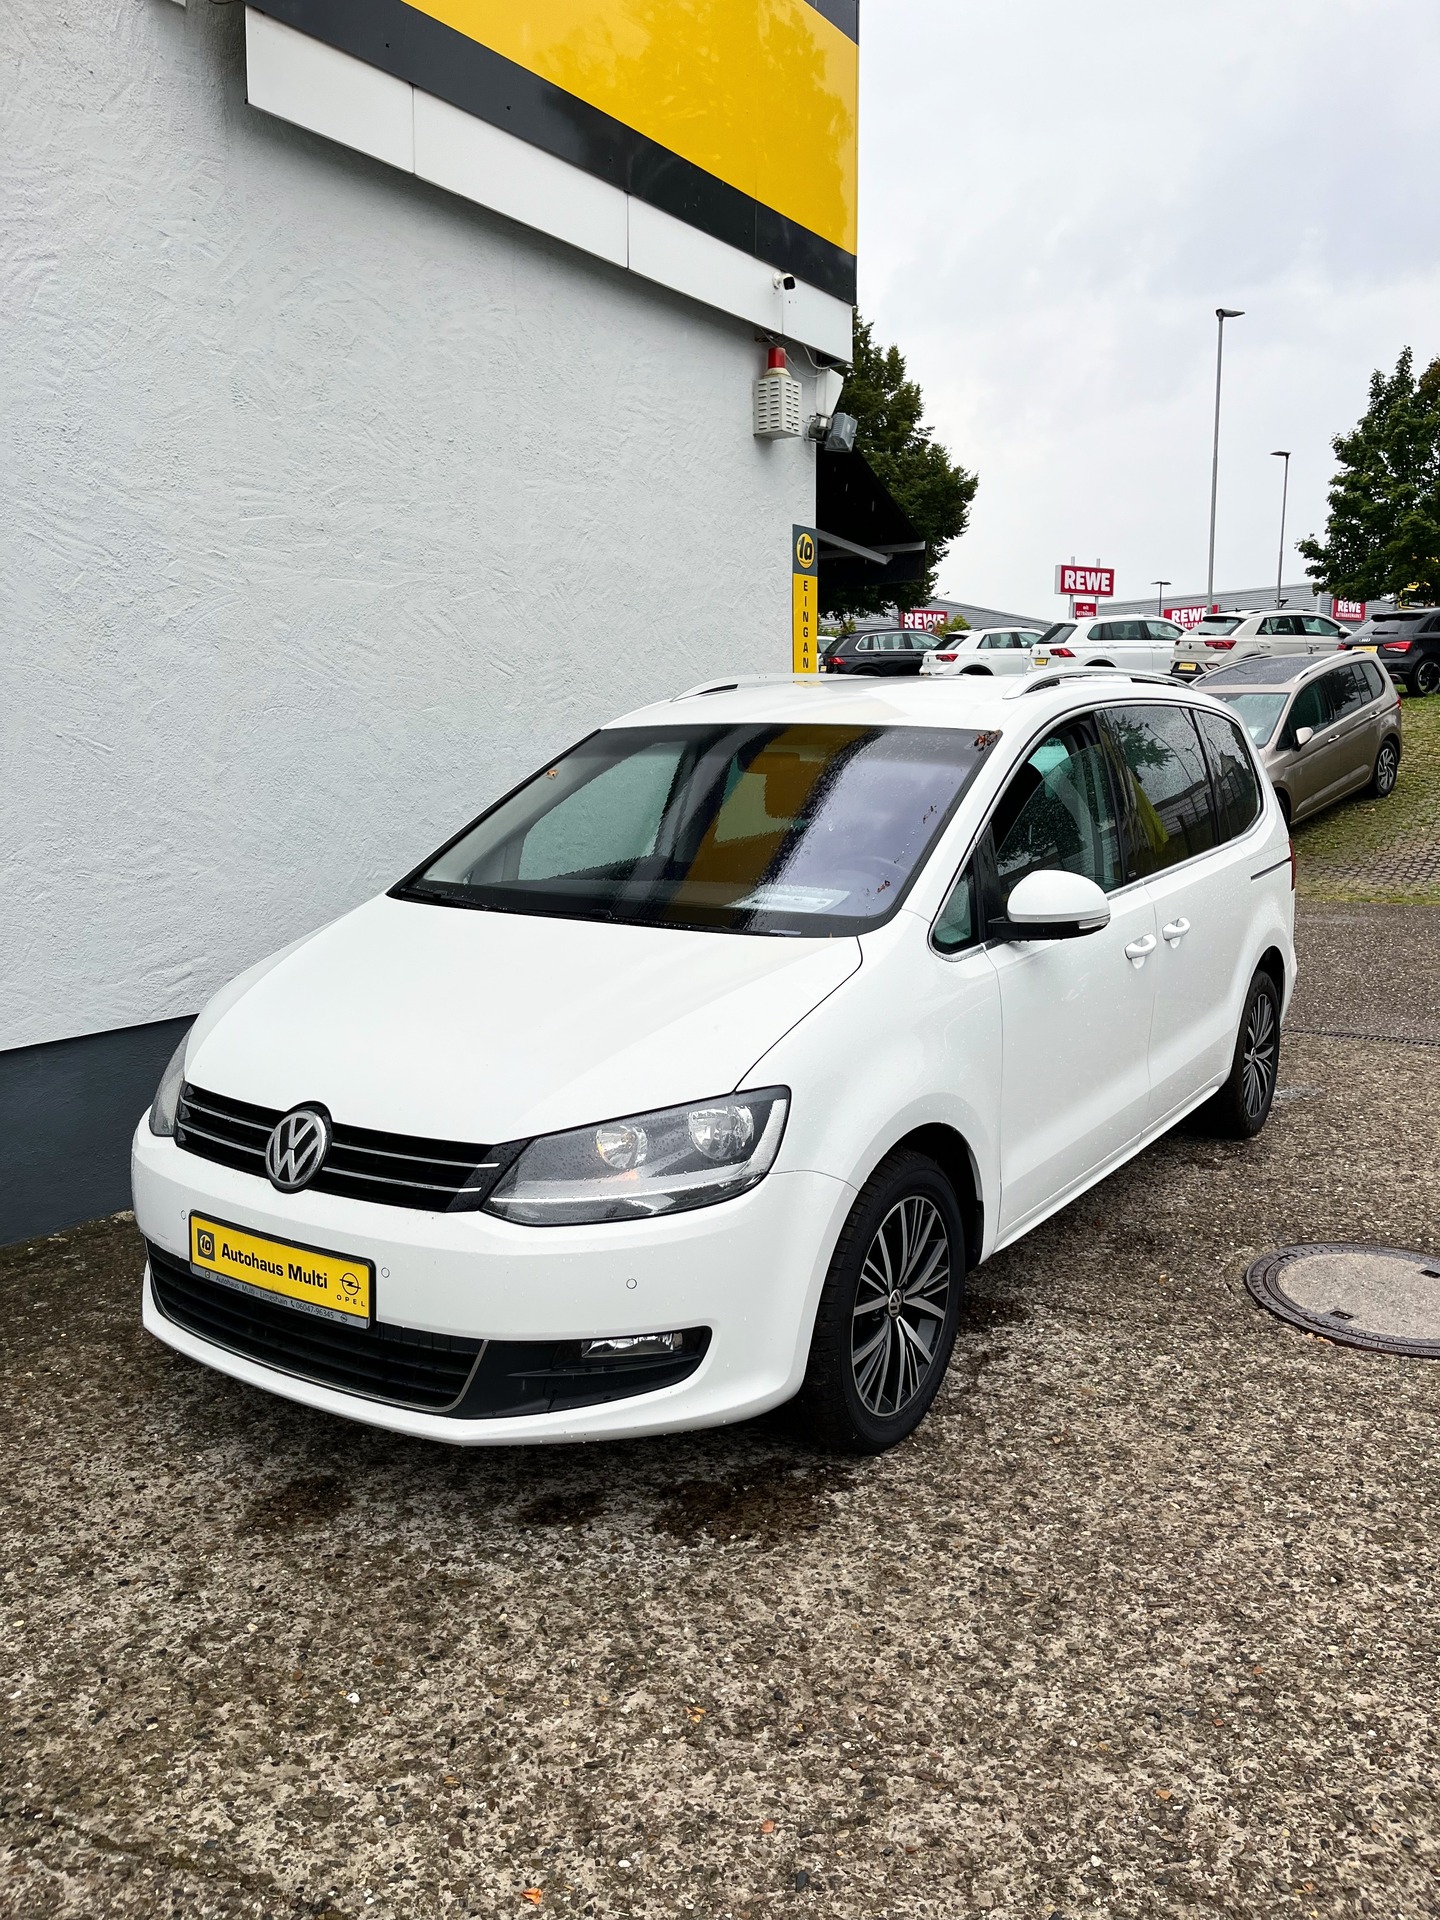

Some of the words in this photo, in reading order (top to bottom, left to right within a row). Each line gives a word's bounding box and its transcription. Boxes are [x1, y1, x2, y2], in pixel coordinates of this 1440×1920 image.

[1064, 570, 1110, 591] REWE
[1337, 600, 1361, 612] REWE
[221, 1243, 284, 1276] Autohaus
[288, 1263, 328, 1289] Multi
[215, 1275, 240, 1290] Autohaus
[336, 1294, 366, 1307] OPEL
